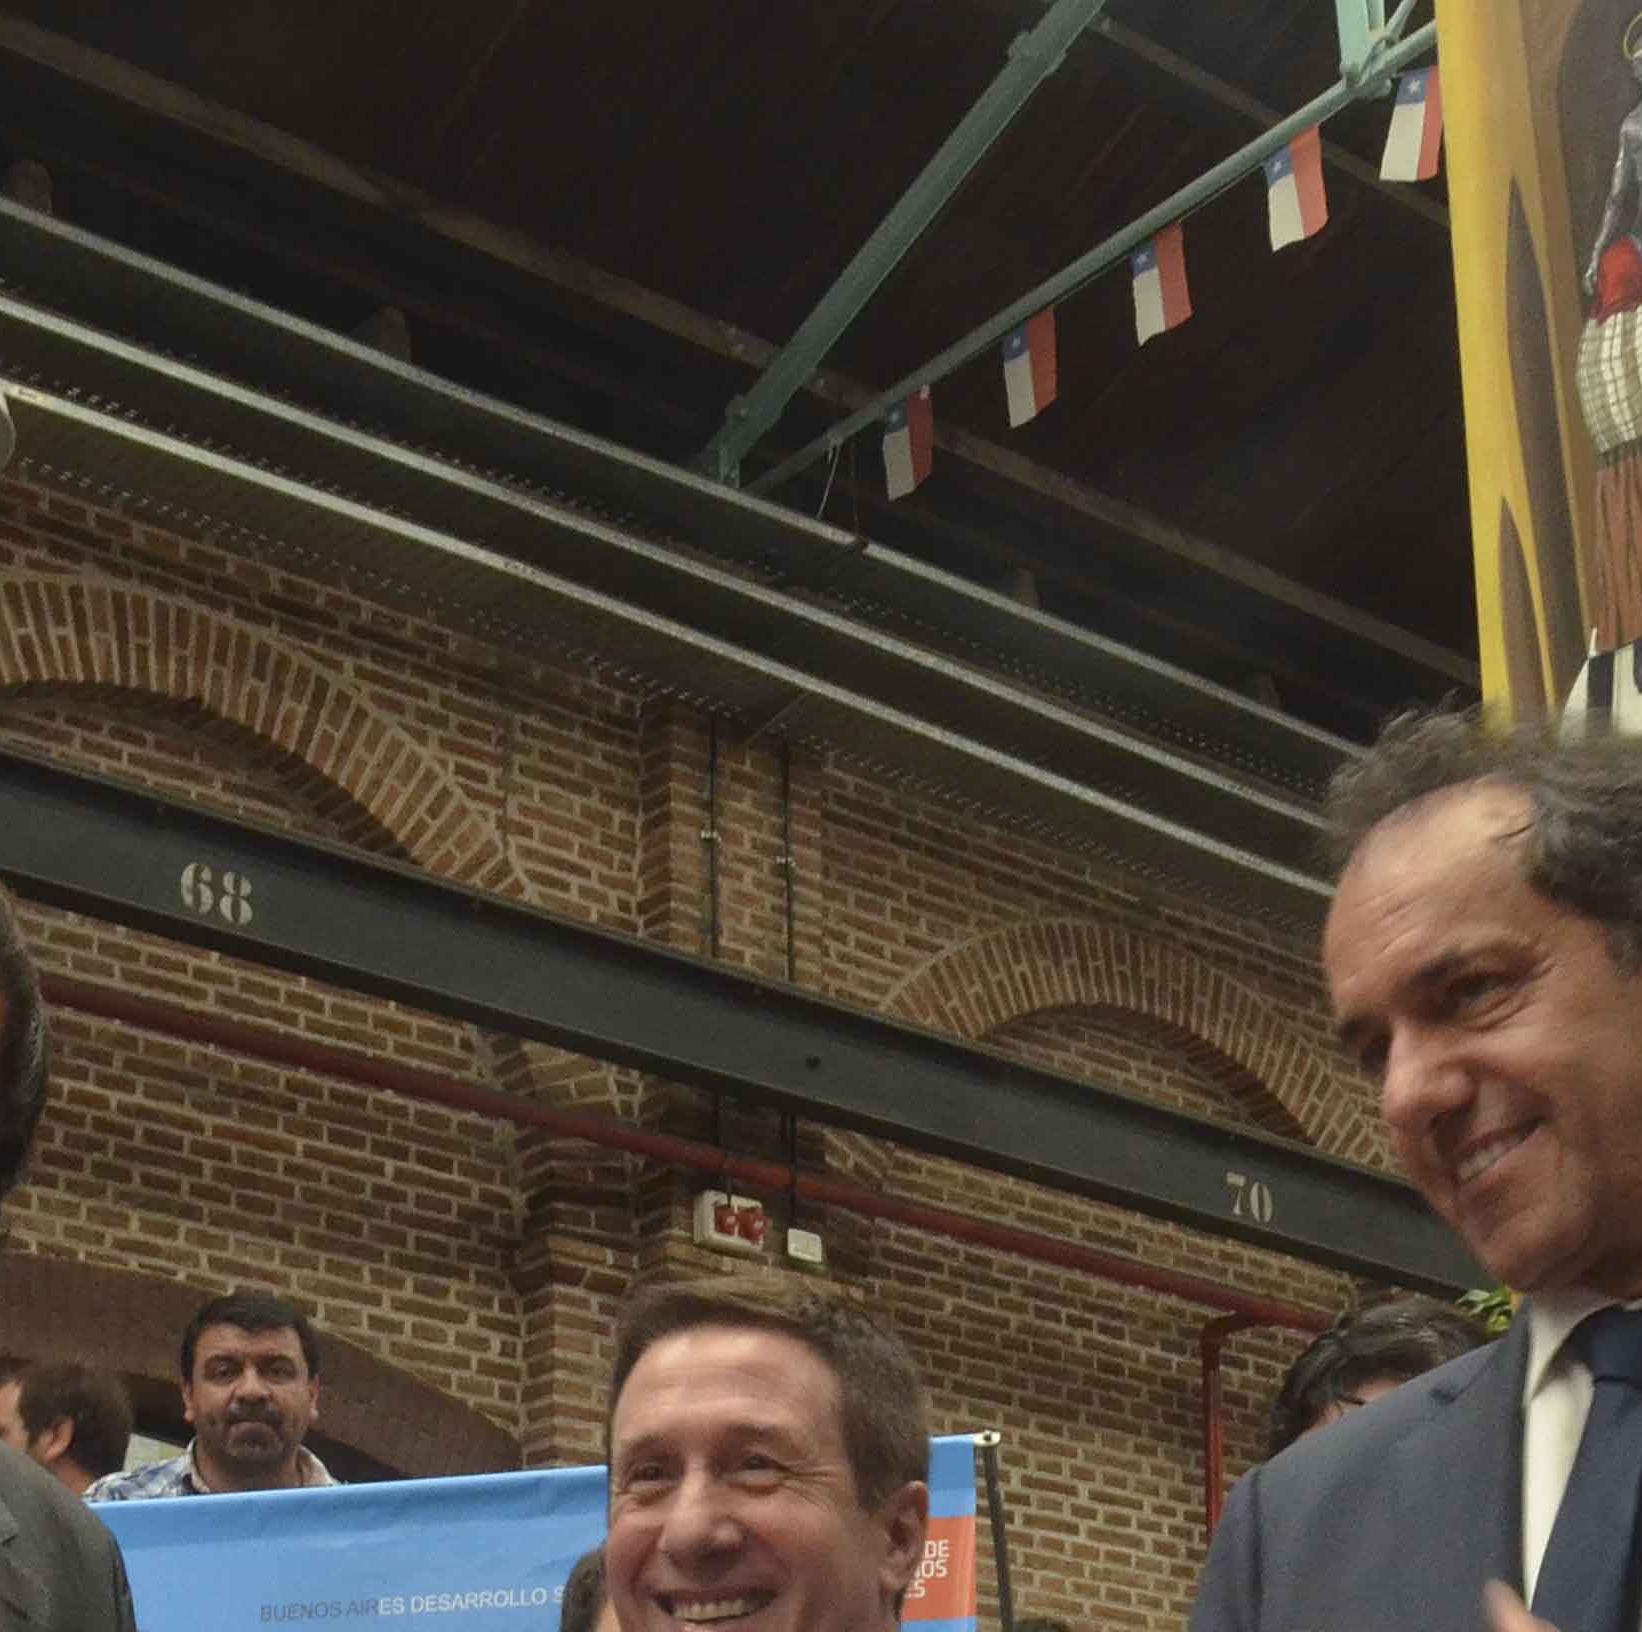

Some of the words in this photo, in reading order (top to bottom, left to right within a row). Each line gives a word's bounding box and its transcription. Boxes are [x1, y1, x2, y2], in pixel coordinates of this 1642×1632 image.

[180, 862, 254, 925] 68
[1226, 1171, 1273, 1223] 70
[924, 1539, 950, 1560] DE
[260, 1599, 343, 1622] BUENOS
[347, 1596, 406, 1617] AIRES
[410, 1587, 548, 1614] DESARROLLO
